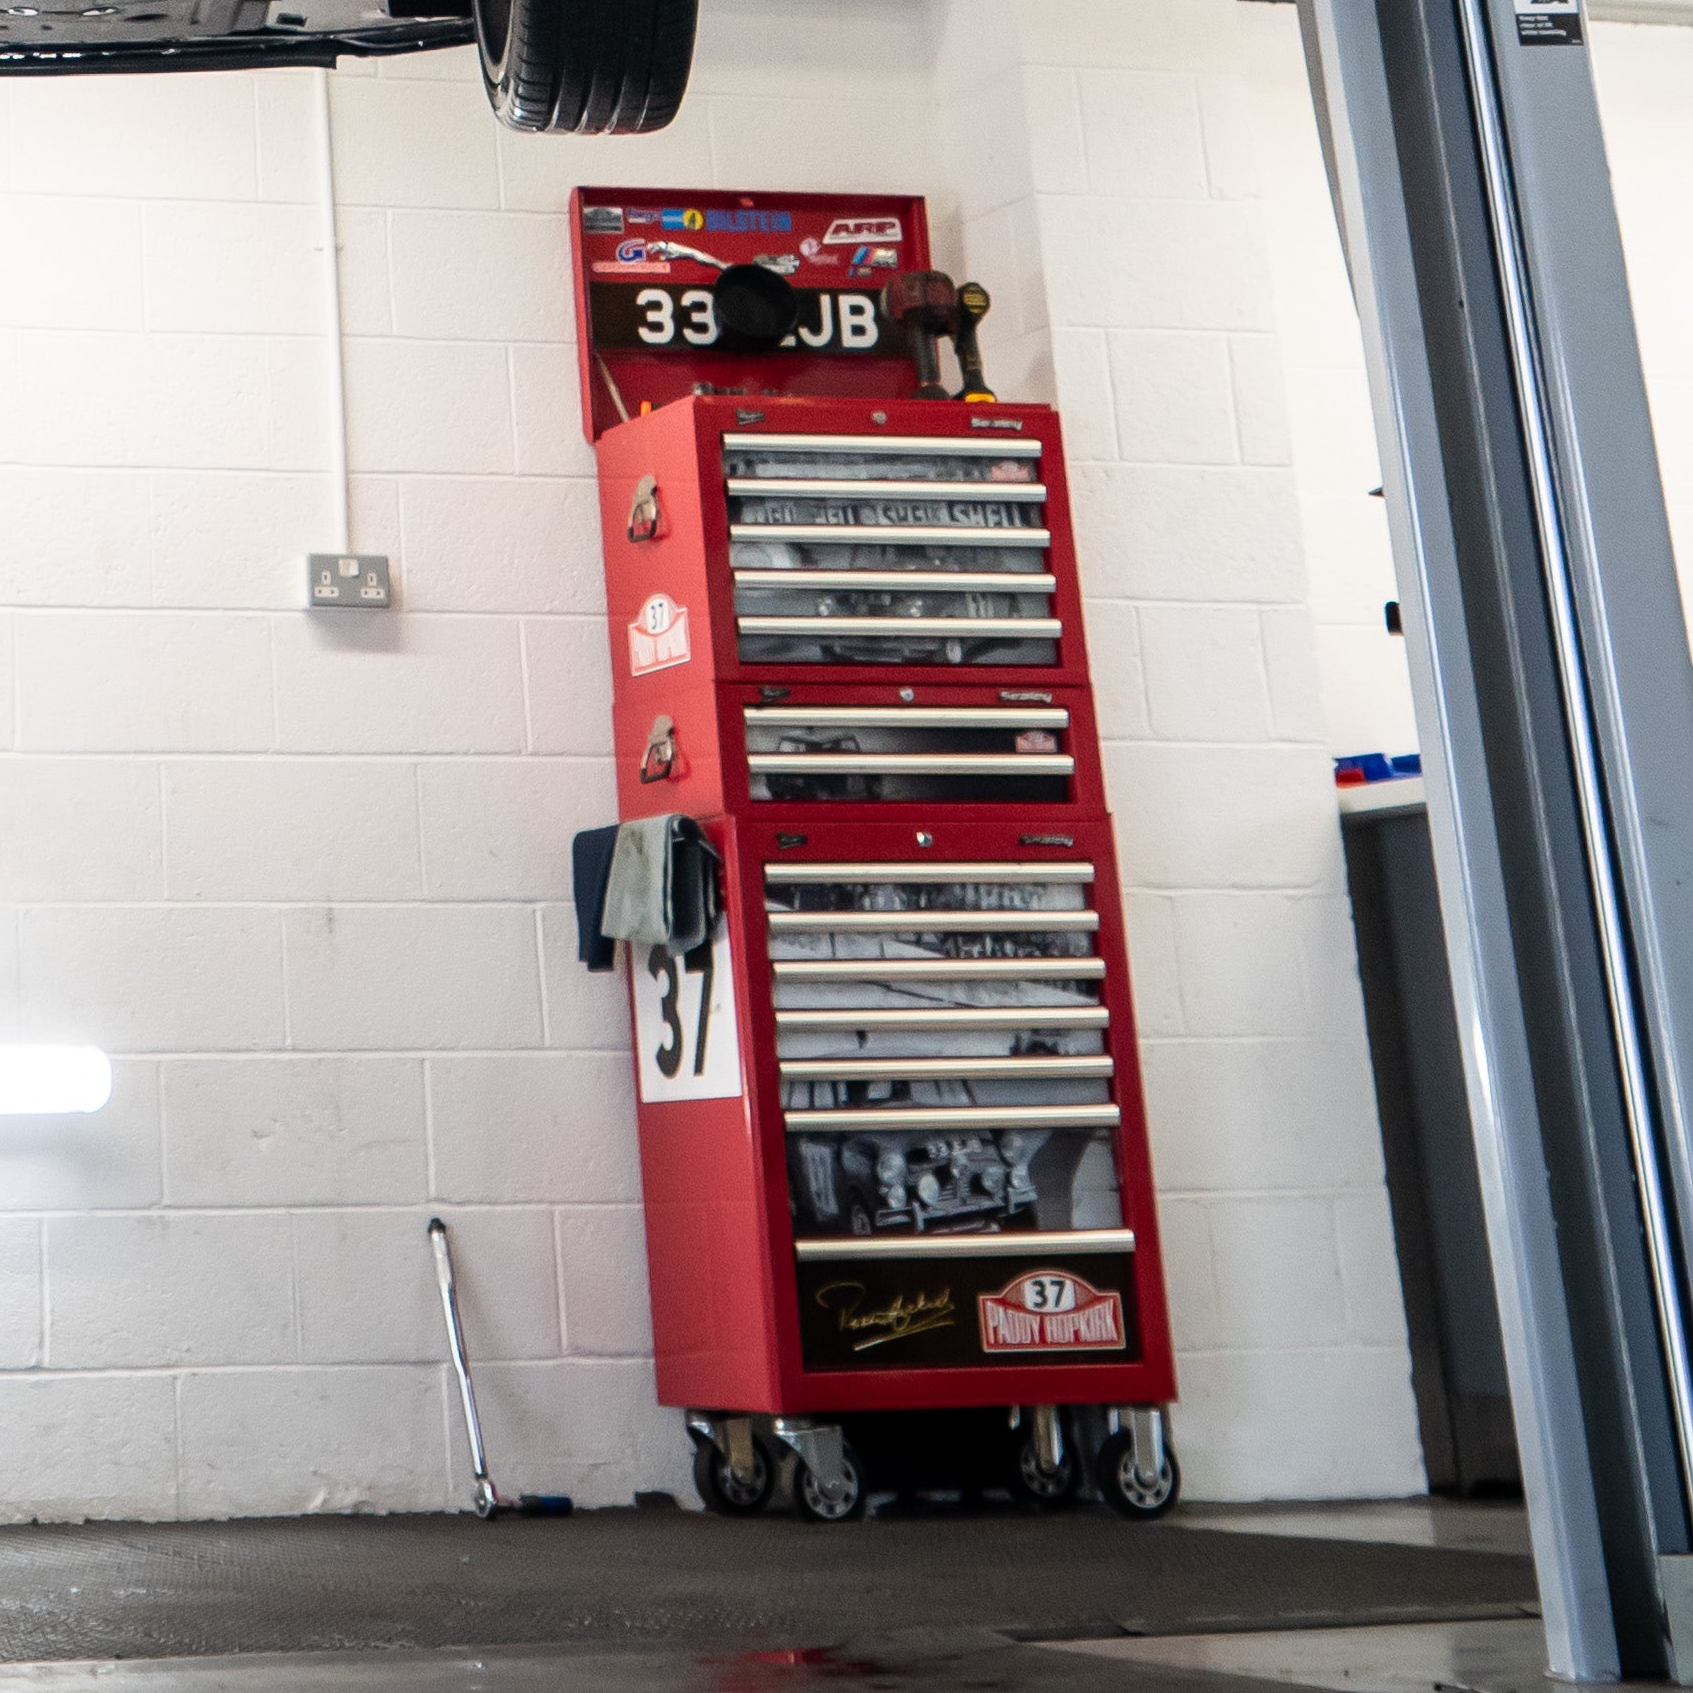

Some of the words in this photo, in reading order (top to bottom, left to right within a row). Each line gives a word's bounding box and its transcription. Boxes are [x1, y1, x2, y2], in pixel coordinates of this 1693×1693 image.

[636, 288, 719, 345] 33
[779, 293, 879, 348] JB
[648, 942, 715, 1079] 37
[1031, 1279, 1066, 1309] 37
[987, 1300, 1041, 1345] PADDY
